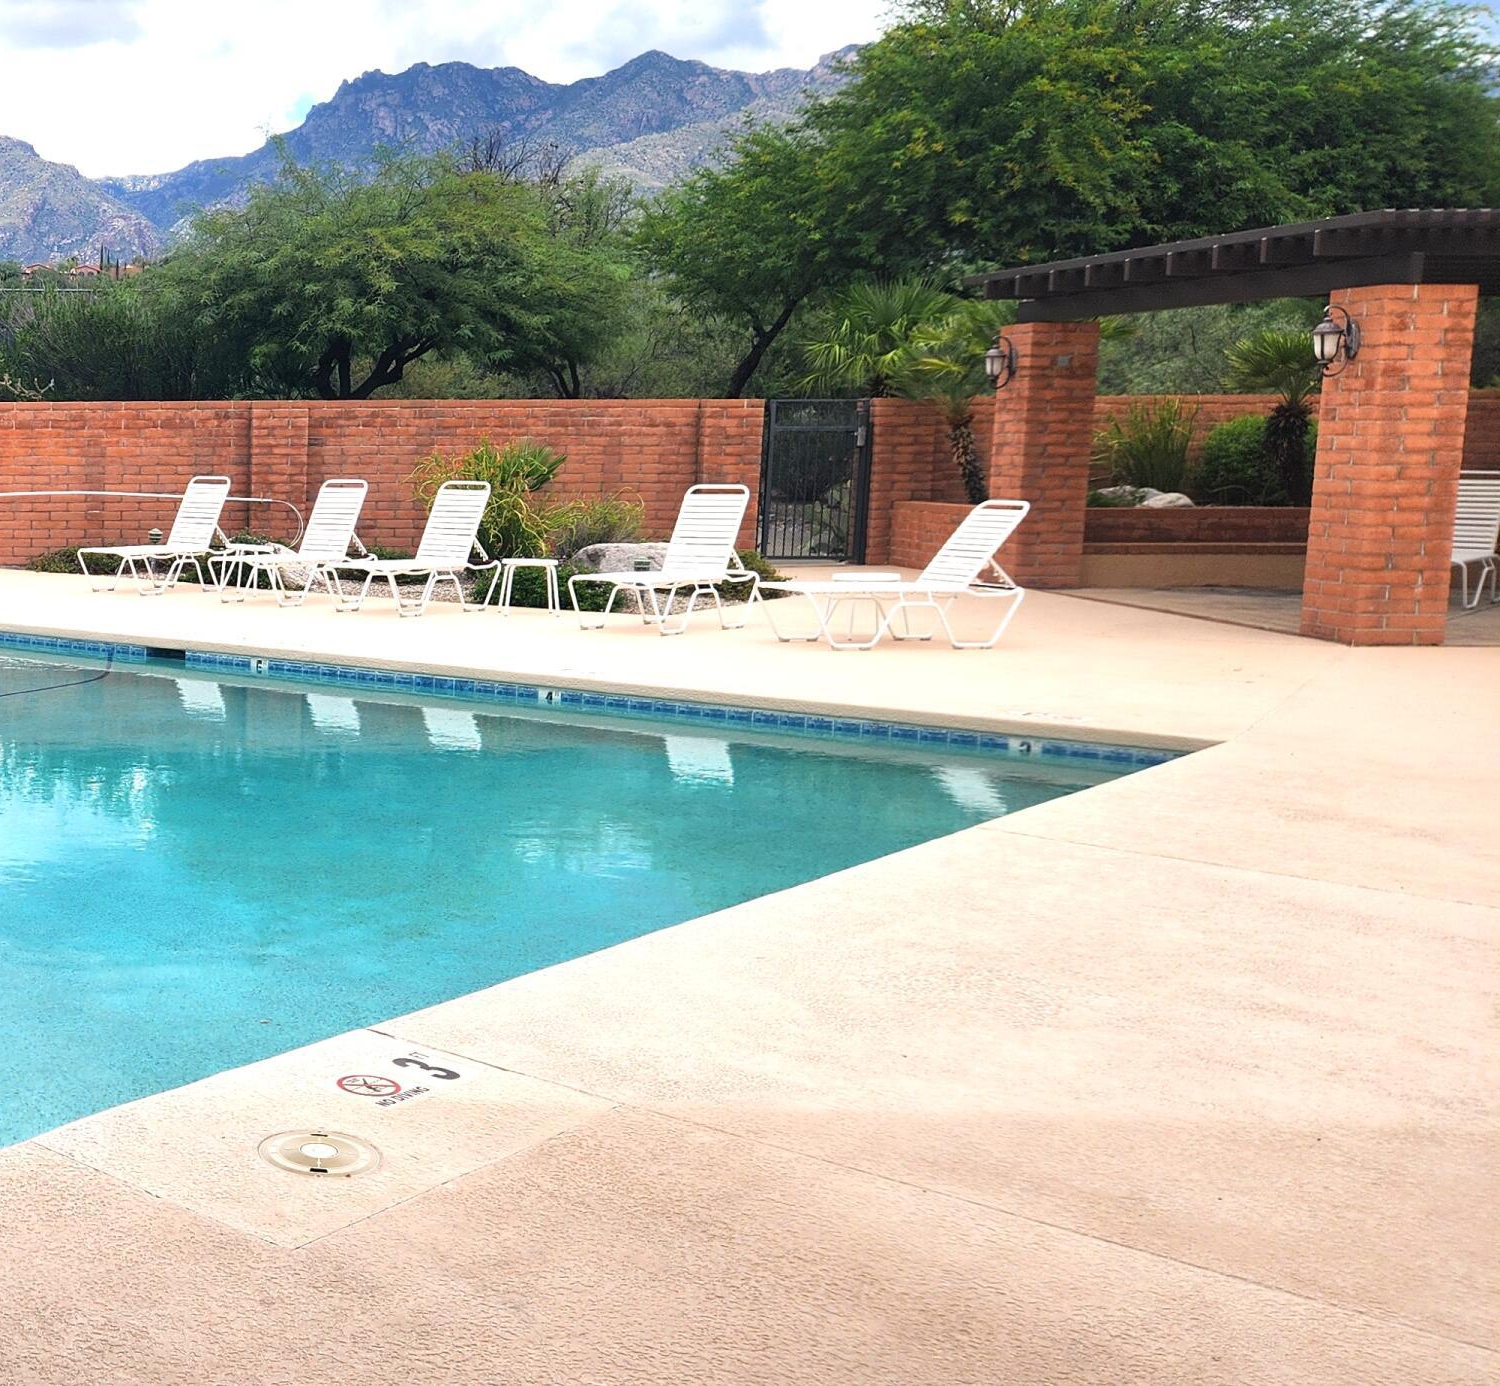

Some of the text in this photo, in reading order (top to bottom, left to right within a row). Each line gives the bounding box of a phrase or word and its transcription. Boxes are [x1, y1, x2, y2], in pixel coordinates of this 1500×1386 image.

[392, 1057, 461, 1080] 3
[375, 1086, 430, 1107] NO DIVING
